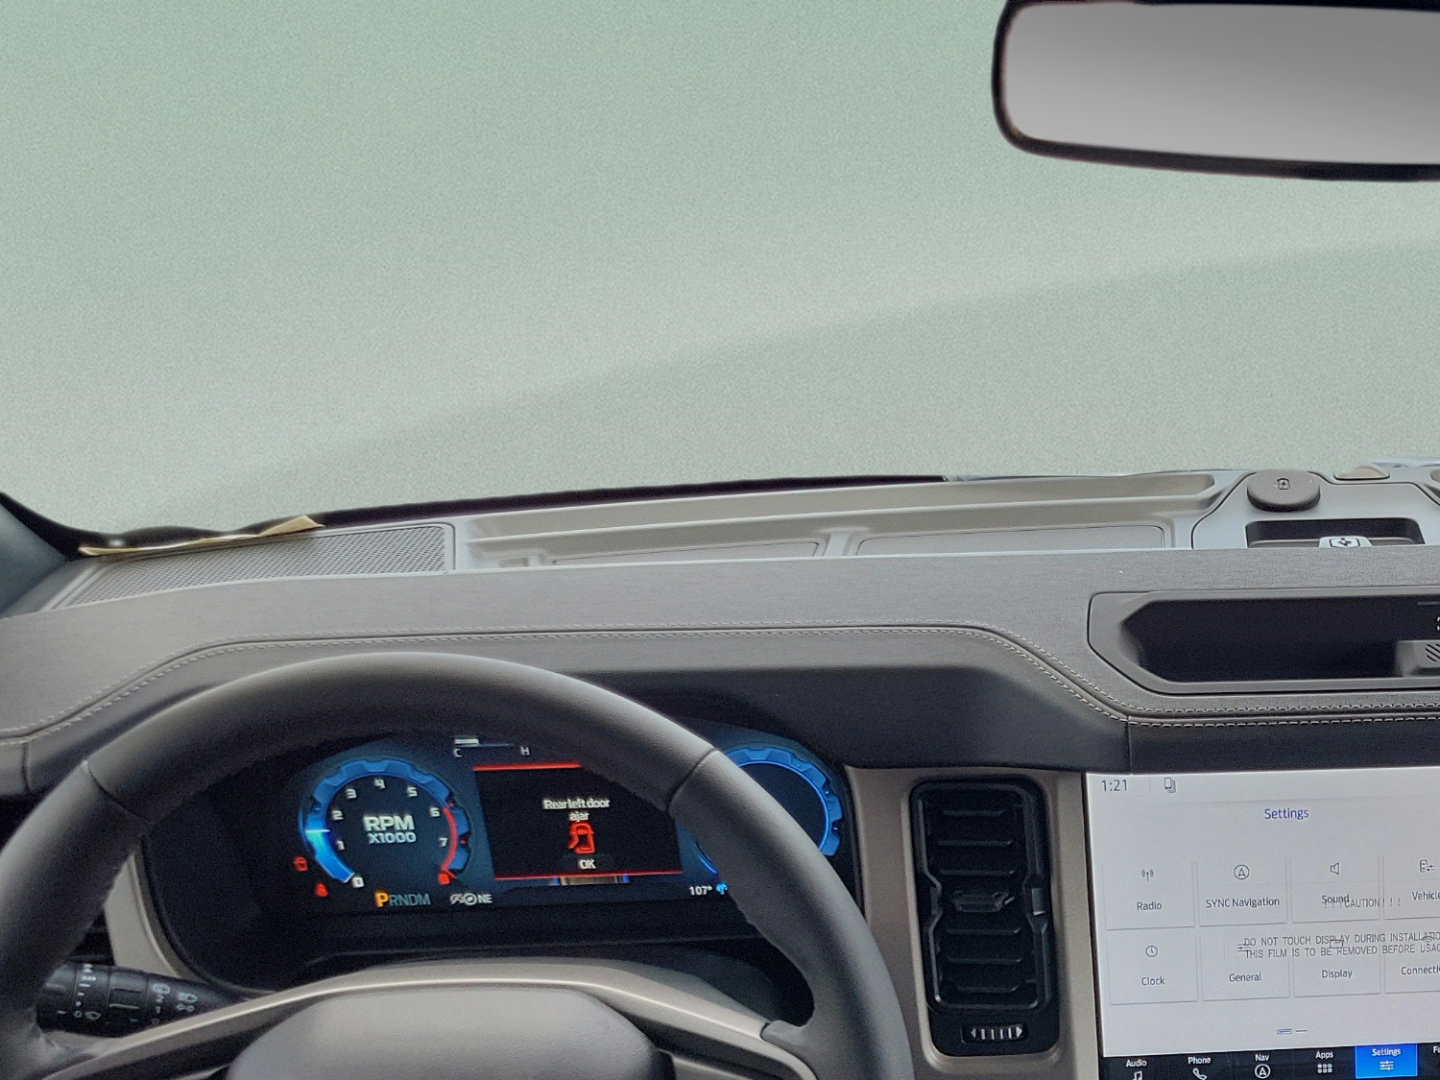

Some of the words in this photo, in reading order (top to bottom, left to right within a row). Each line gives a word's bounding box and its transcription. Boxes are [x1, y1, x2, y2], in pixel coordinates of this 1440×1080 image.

[453, 748, 462, 758] C
[520, 746, 530, 756] H
[1100, 779, 1128, 792] 1:21
[346, 788, 357, 799] 3
[407, 786, 418, 798] 5
[543, 798, 568, 810] Rear
[568, 798, 586, 808] left
[586, 798, 610, 808] door
[332, 810, 344, 820] 2
[430, 806, 440, 818] 6
[569, 812, 590, 822] ajar
[1264, 808, 1309, 820] Settings
[363, 816, 415, 832] RPM
[368, 832, 416, 844] X1000
[438, 837, 449, 848] 7
[336, 840, 345, 850] 1
[578, 858, 596, 870] OK
[1206, 898, 1230, 908] SYNC
[1232, 898, 1280, 909] Navigation
[1322, 894, 1350, 904] Sound
[1136, 901, 1162, 911] Radio
[1244, 937, 1256, 946] DO
[1260, 936, 1278, 946] NOT
[1282, 936, 1311, 946] TOUCH
[1316, 934, 1350, 944] DISPLAY
[1354, 933, 1386, 943] DURING
[1245, 949, 1264, 959] THIS
[1268, 948, 1287, 958] FILM
[1292, 948, 1300, 957] IS
[1304, 948, 1316, 956] TO
[1320, 946, 1332, 956] BE
[1336, 946, 1378, 956] REMOVED
[1382, 944, 1416, 954] BEFORE
[1228, 972, 1262, 982] General
[1322, 969, 1352, 980] Display
[1141, 976, 1166, 986] Clock
[1255, 1053, 1270, 1062] Nav
[1315, 1050, 1334, 1060] Apps
[1372, 1046, 1402, 1058] Settings
[1126, 1058, 1148, 1068] Audio
[1188, 1056, 1212, 1065] Phone
